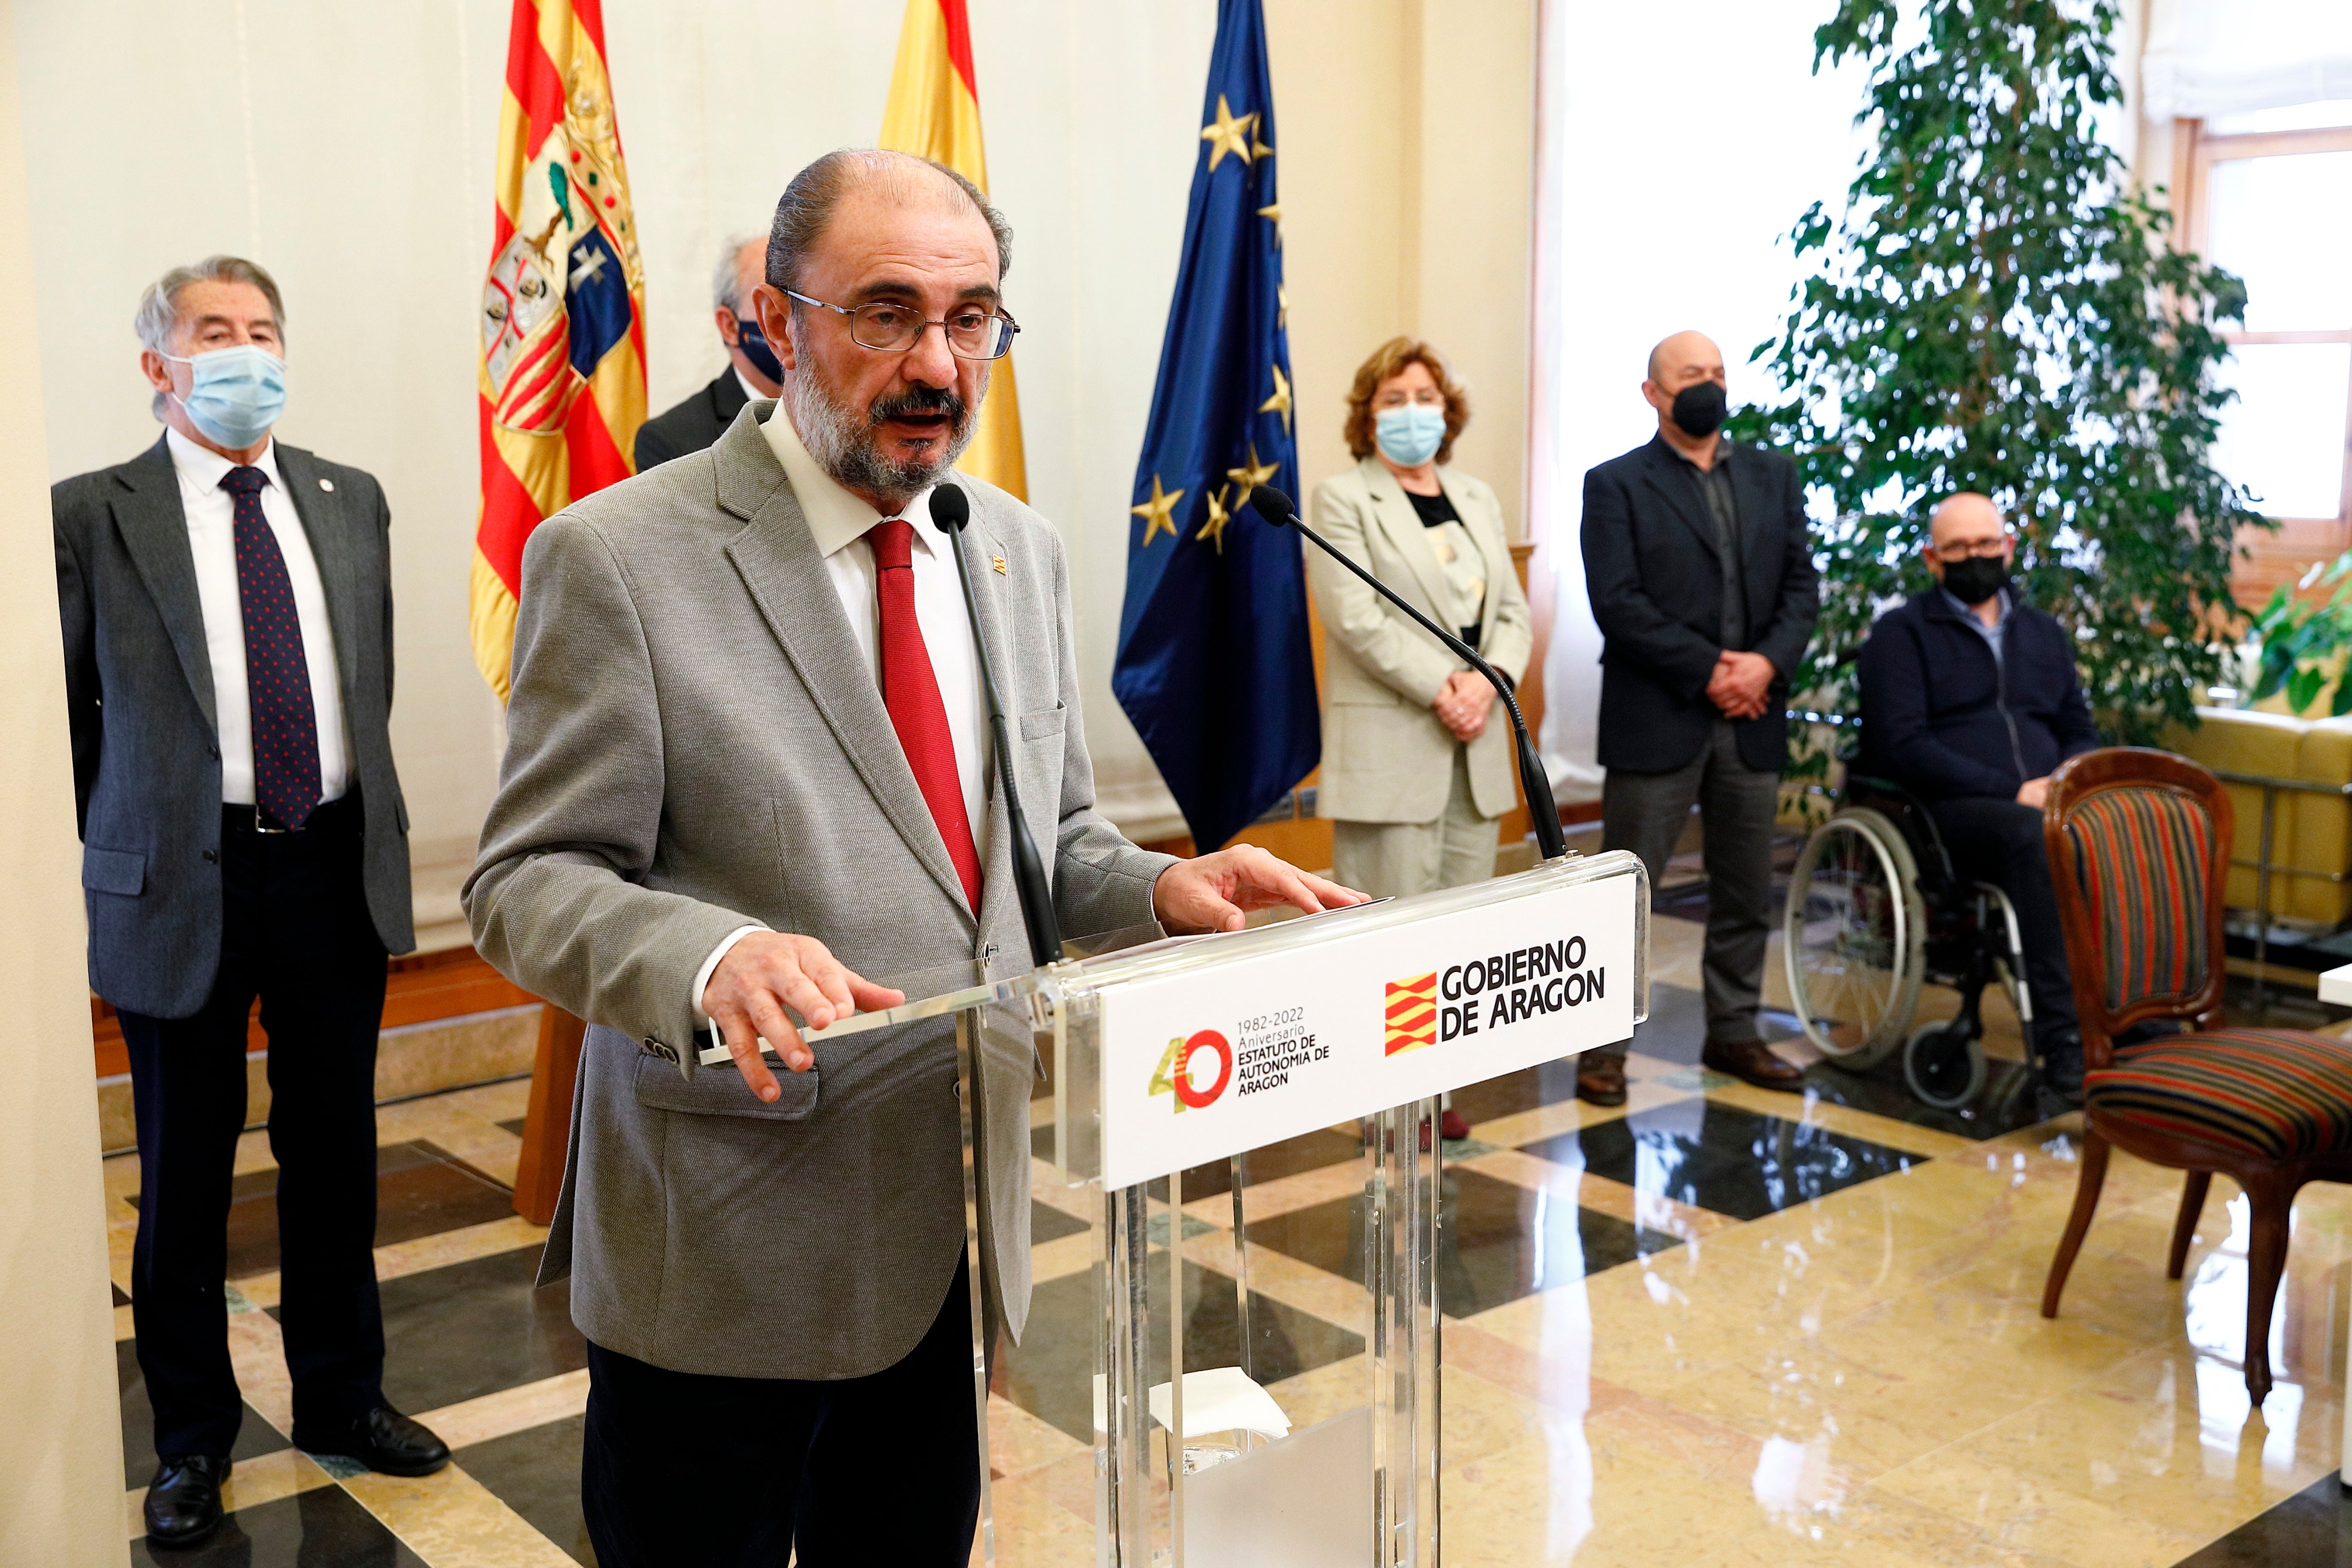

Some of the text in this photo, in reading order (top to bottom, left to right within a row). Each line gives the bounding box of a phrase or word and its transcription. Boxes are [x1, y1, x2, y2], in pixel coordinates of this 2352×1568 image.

[1442, 936, 1586, 1001] GOBIERNO
[1238, 1007, 1303, 1034] 1982-2022
[1441, 967, 1604, 1042] DE ARAGON
[1238, 1024, 1305, 1051] Aniversario
[1239, 1034, 1315, 1066] ESTATUTO DE
[1238, 1045, 1329, 1081] AUTONOMIA DE
[1238, 1072, 1288, 1097] ARAGON
